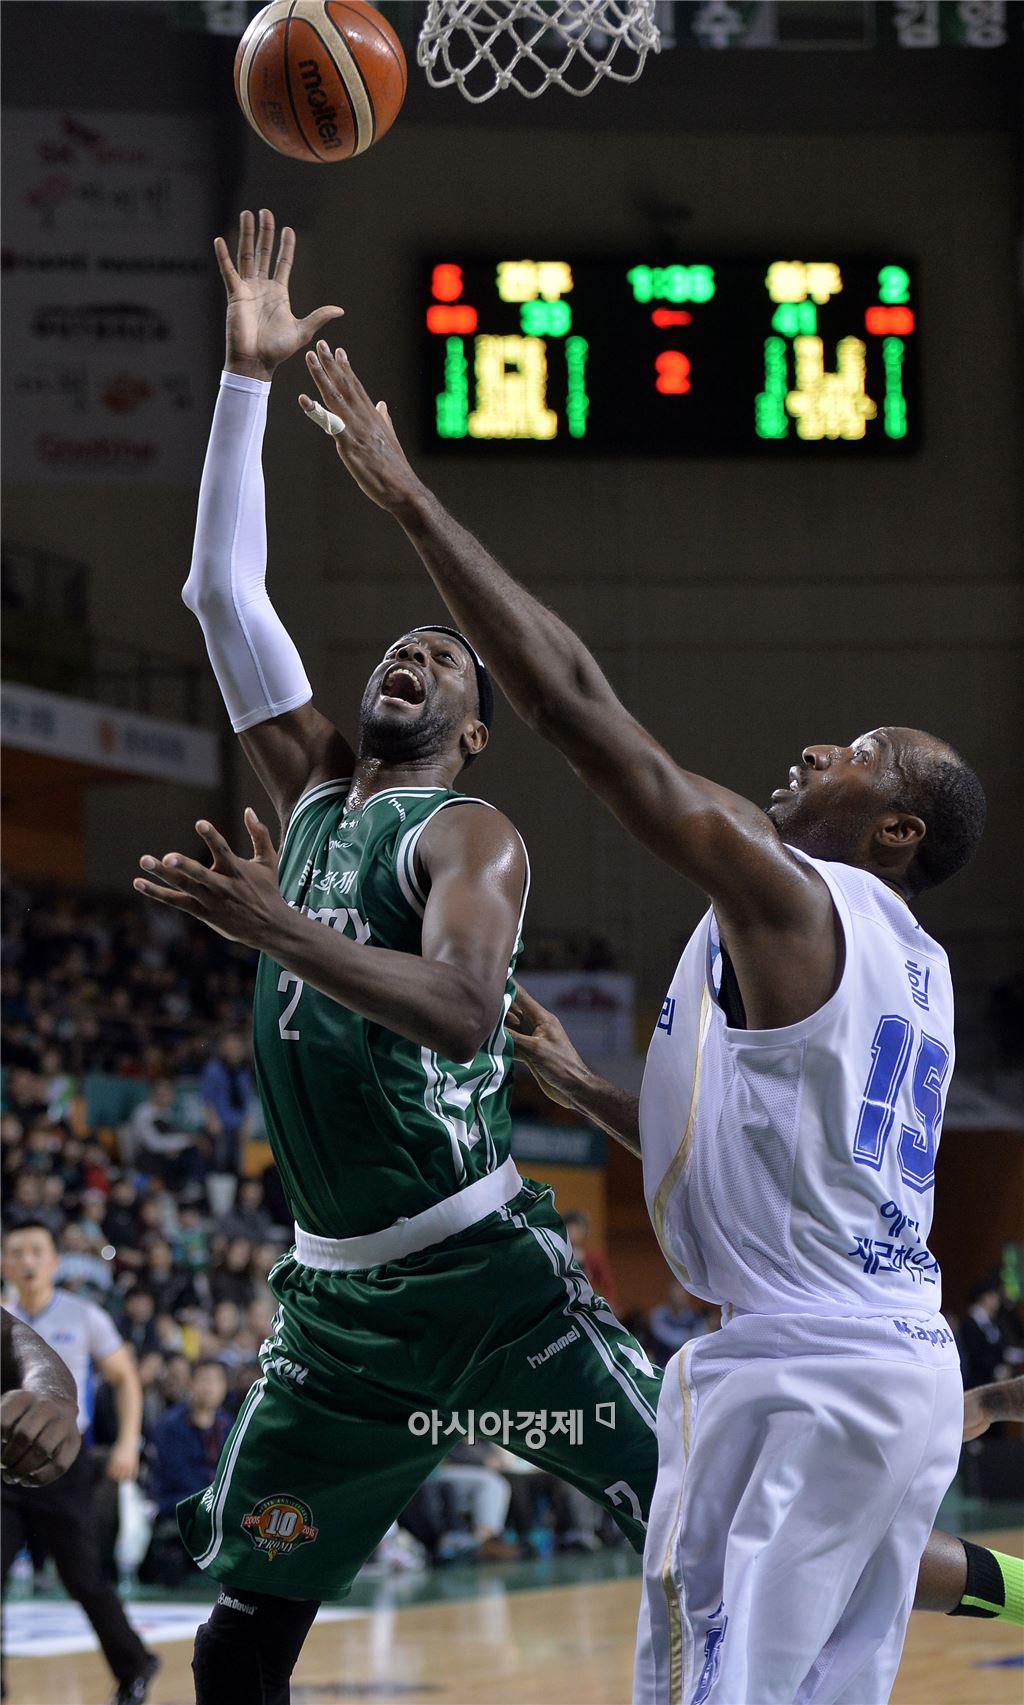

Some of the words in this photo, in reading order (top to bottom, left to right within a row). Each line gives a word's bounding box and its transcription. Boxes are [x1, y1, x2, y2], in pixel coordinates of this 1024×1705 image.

[298, 59, 342, 150] molten
[277, 970, 304, 1040] 2
[853, 1014, 950, 1194] 15
[526, 1324, 581, 1369] hummel
[265, 1508, 298, 1537] 10
